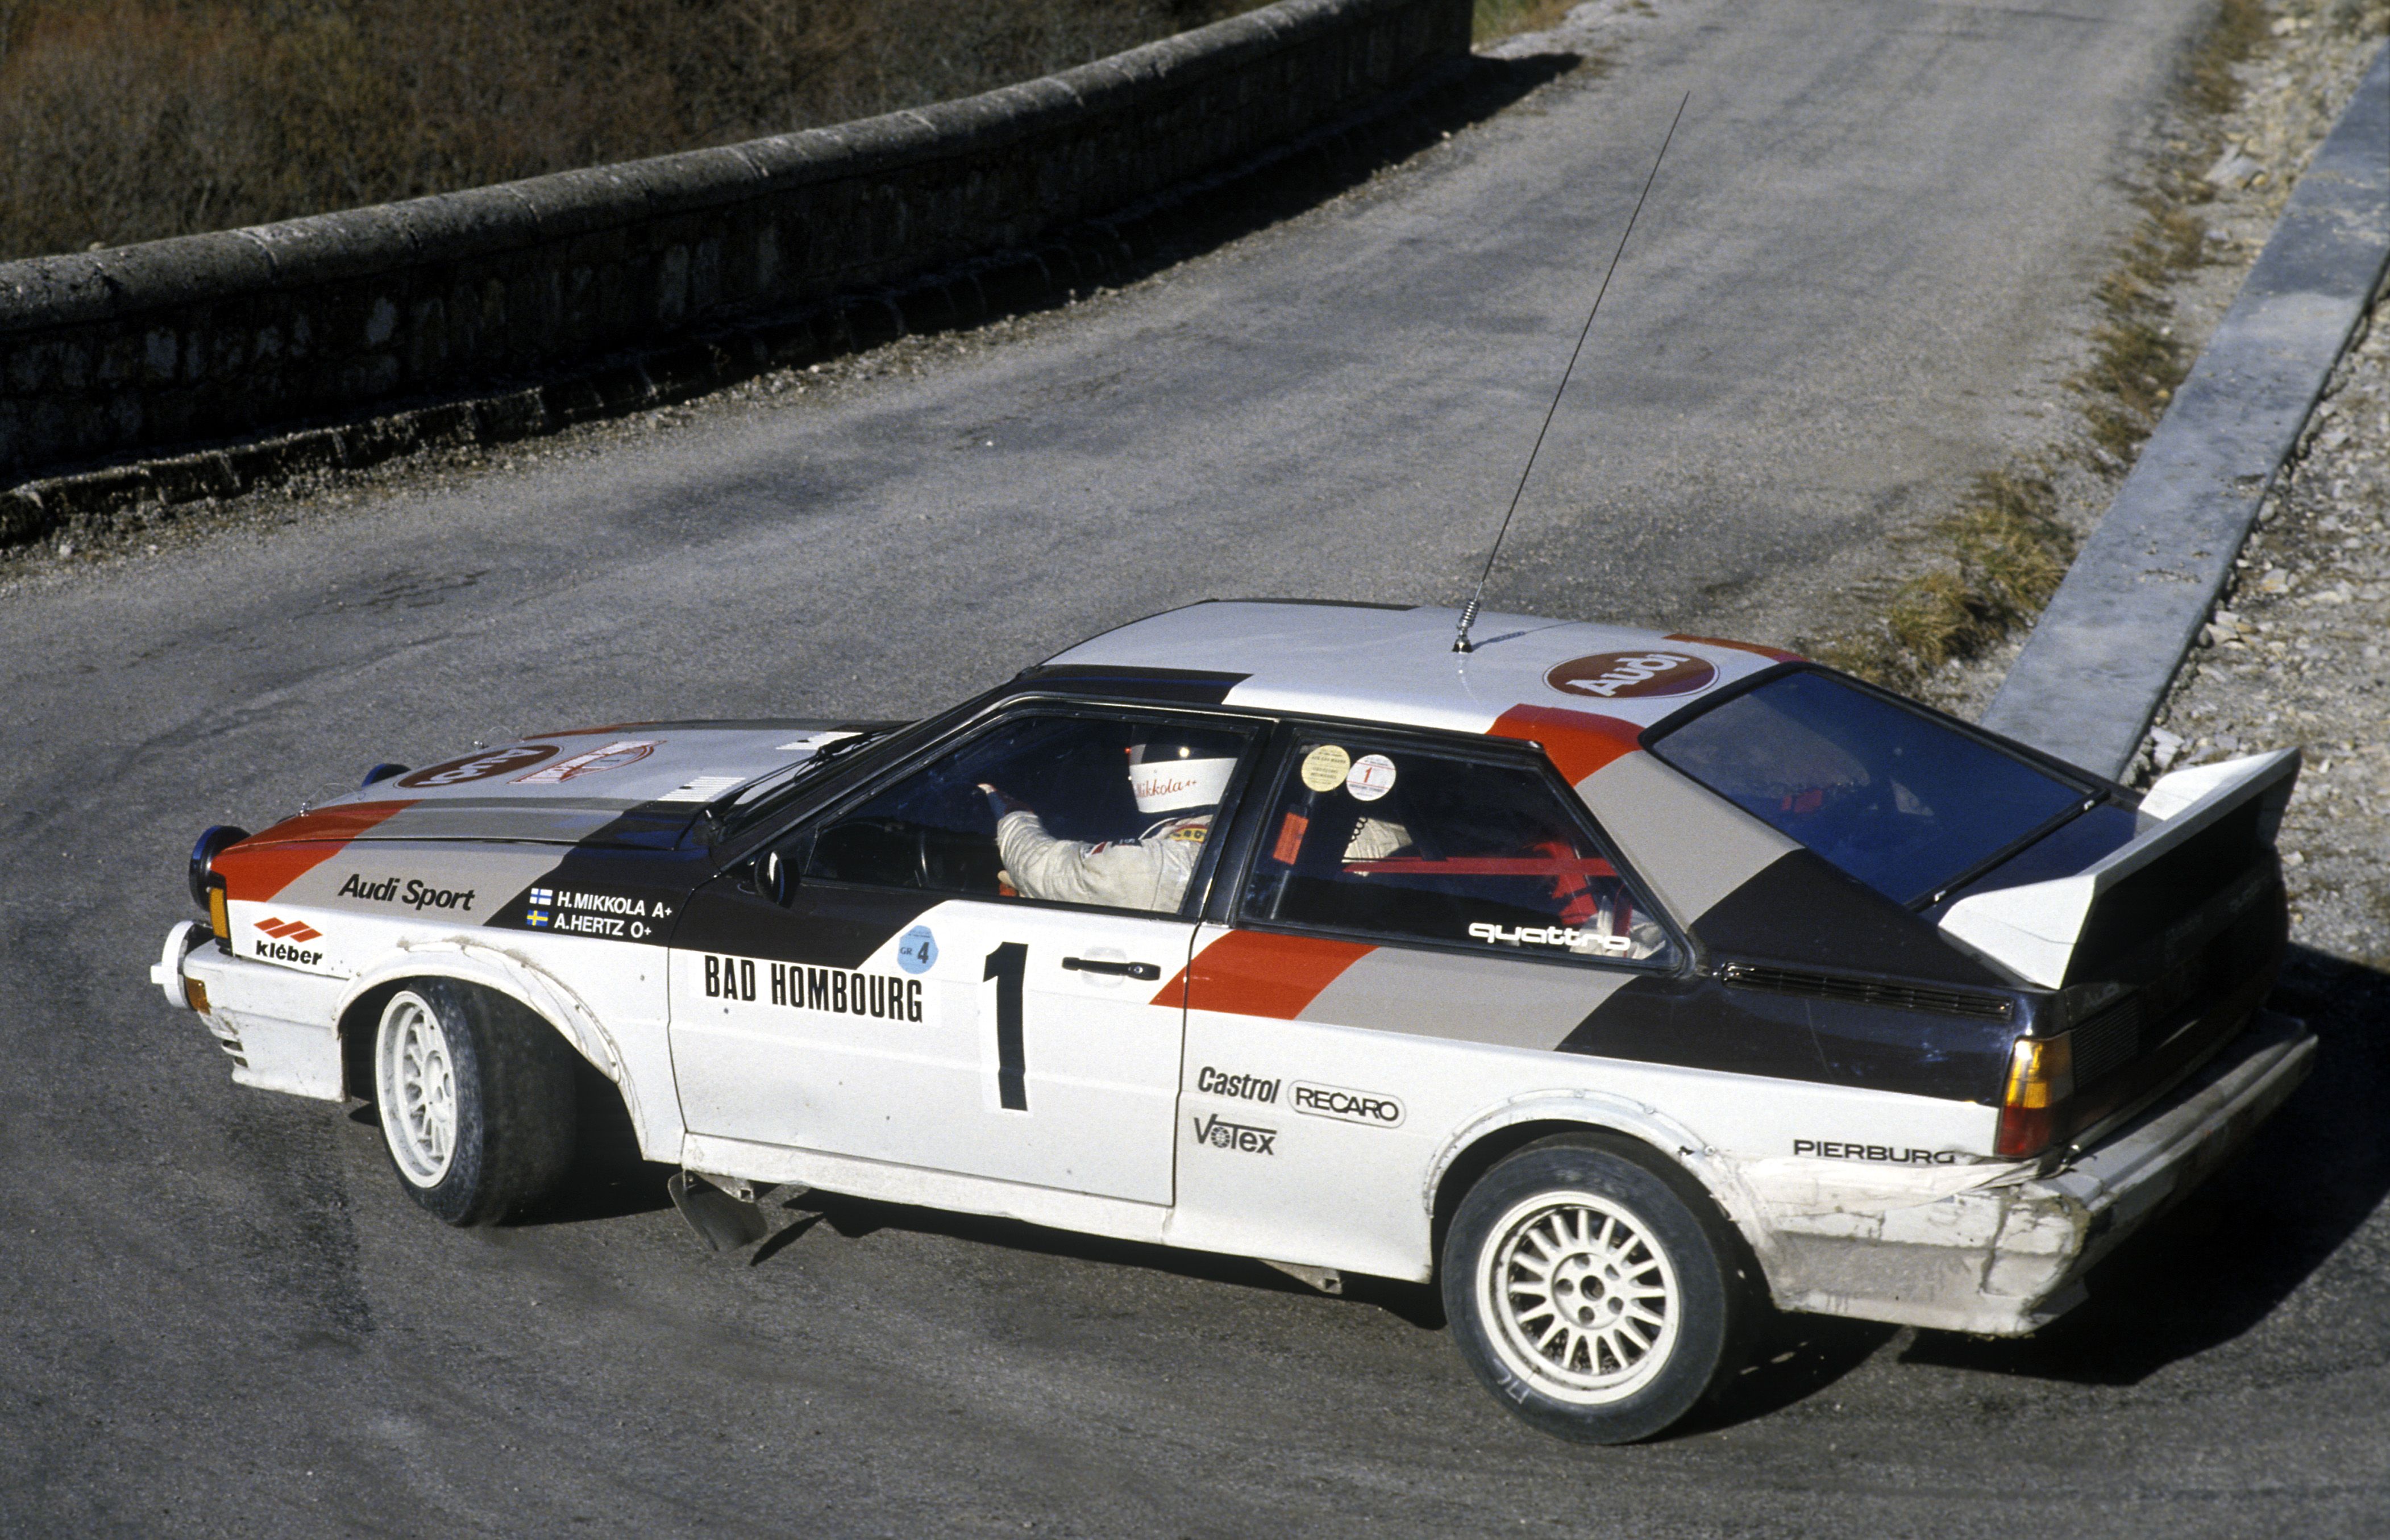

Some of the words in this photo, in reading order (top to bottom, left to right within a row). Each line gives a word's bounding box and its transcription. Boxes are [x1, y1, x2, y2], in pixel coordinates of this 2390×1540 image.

[1565, 654, 1690, 697] Audi
[1364, 767, 1373, 783] 1
[338, 873, 398, 900] Audi
[401, 879, 475, 911] Sport
[557, 891, 645, 916] H.MIKKOLA
[651, 902, 672, 918] A+
[554, 913, 625, 936] A.HERTZ
[1469, 922, 1631, 951] quattro
[917, 942, 929, 964] 4
[704, 955, 757, 1002] BAD
[771, 963, 924, 1023] HOMBOURG
[983, 941, 1029, 1112] 1
[1198, 1066, 1281, 1104] Castrol
[1296, 1087, 1399, 1122] RECARO
[1794, 1139, 1955, 1164] PIERBURG
